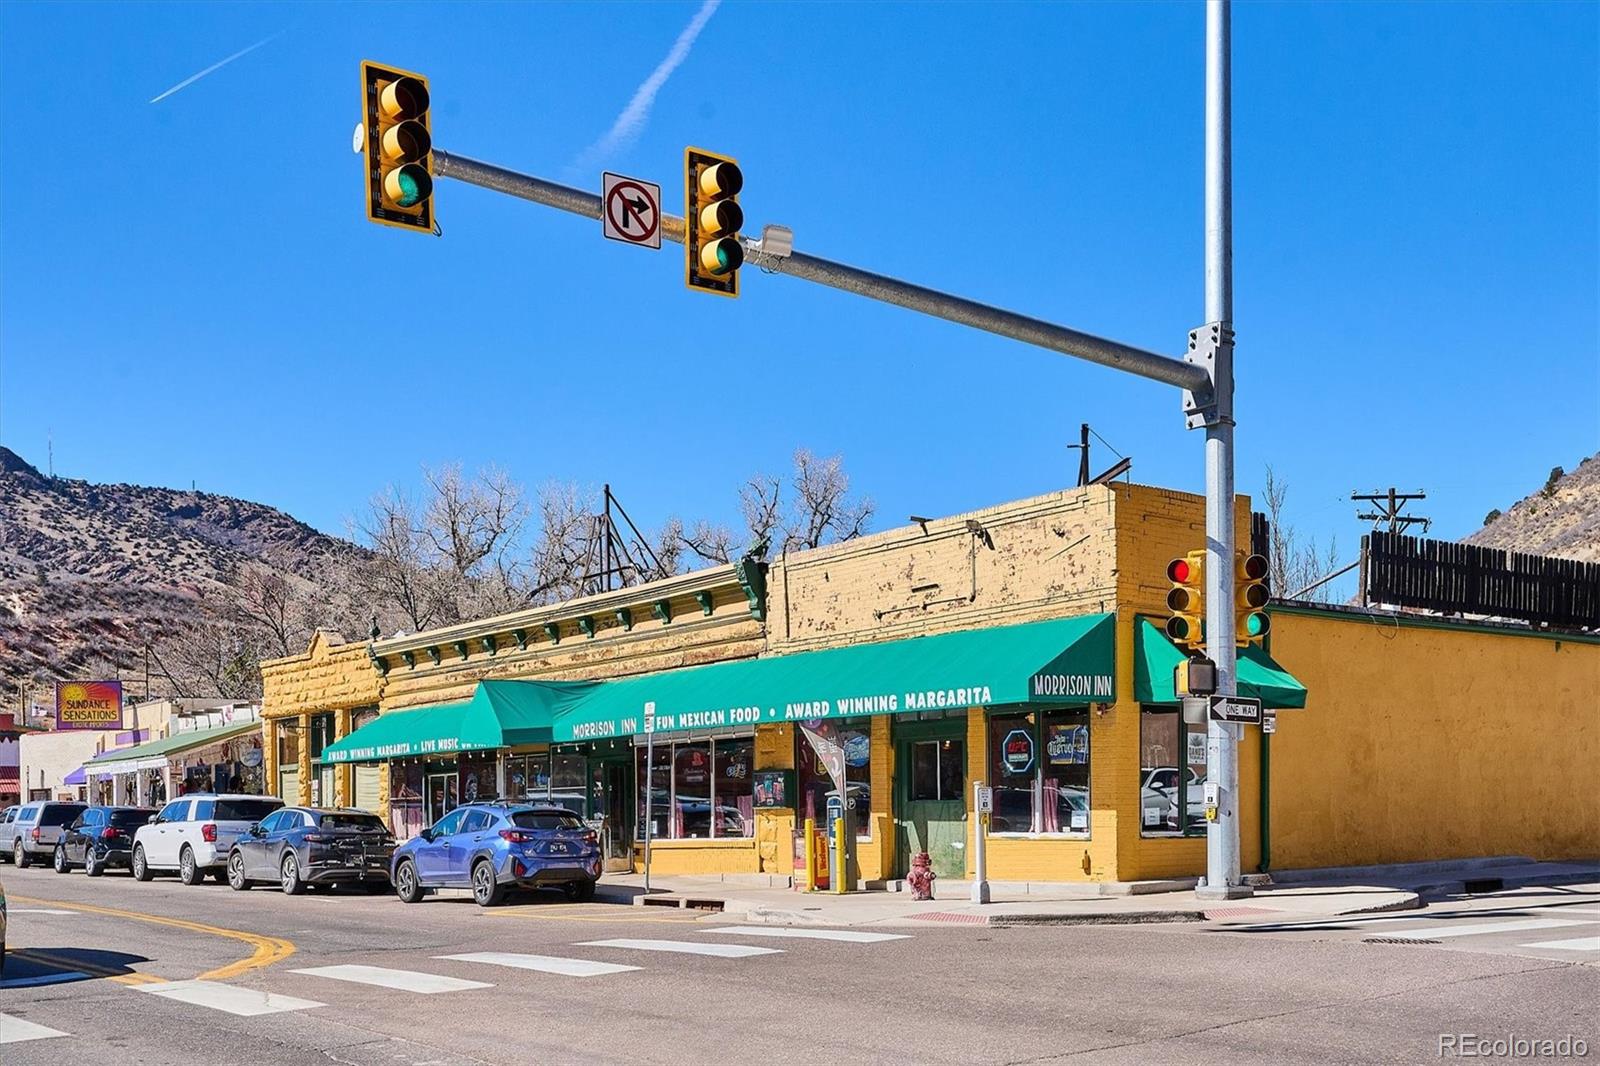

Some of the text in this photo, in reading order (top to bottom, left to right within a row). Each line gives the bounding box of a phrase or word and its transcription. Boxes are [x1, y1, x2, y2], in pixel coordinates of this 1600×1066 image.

[1034, 674, 1112, 696] MORRISON INN
[66, 700, 111, 710] SUNDANCE
[573, 720, 615, 739] MORRISON
[621, 717, 637, 735] INN
[656, 715, 675, 729] FUN
[679, 709, 725, 727] MEXICAN
[730, 706, 760, 724] FOOD
[785, 701, 830, 719] AWARD
[837, 694, 898, 715] WINNING
[905, 686, 992, 709] MARGARITA
[1226, 704, 1256, 717] ONE WAY
[63, 710, 118, 720] SENSATIONS
[328, 750, 348, 762] AWARD
[350, 746, 375, 760] WINNING
[377, 742, 410, 757] MARGARITA
[421, 740, 436, 752] LIVE
[437, 737, 459, 750] MUSIC
